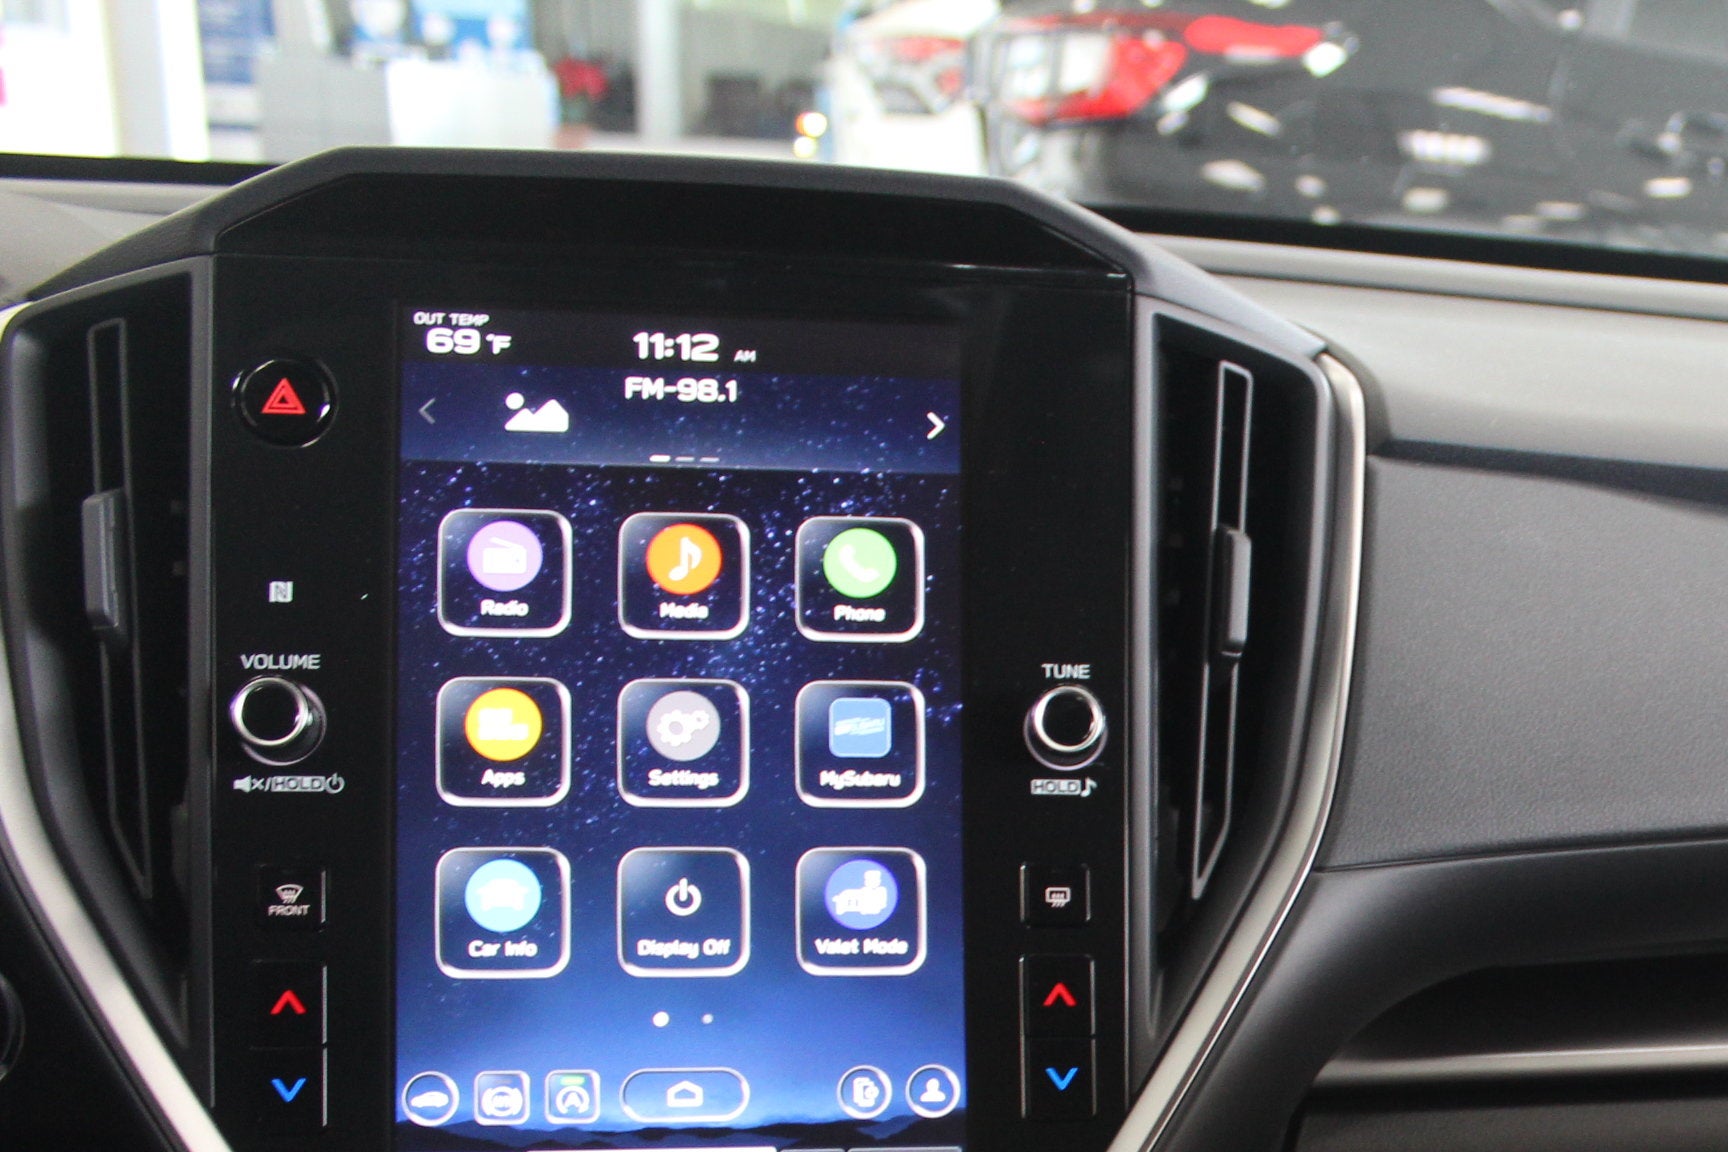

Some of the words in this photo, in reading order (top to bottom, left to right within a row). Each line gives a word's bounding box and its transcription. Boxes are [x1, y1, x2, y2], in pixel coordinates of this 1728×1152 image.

[413, 311, 446, 326] OUT
[449, 313, 490, 327] TEMP
[426, 327, 482, 355] 69
[632, 331, 720, 362] 11:12
[734, 350, 757, 363] AM
[624, 376, 738, 403] FM-98.1
[480, 599, 529, 617] Radio
[659, 602, 709, 620] Media
[833, 605, 886, 623] Phone
[240, 653, 321, 670] VOLUME
[1041, 663, 1091, 679] TUNE
[272, 776, 325, 792] HOLD
[481, 769, 525, 788] Apps
[647, 769, 719, 789] Settings
[819, 769, 901, 790] MySubaru
[1030, 779, 1081, 795] HOLD
[268, 905, 310, 917] FRONT
[468, 940, 500, 957] Car
[504, 940, 538, 957] Info
[637, 938, 699, 959] Display
[702, 938, 730, 956] Off
[814, 938, 858, 955] Valet
[862, 939, 908, 955] Mode
